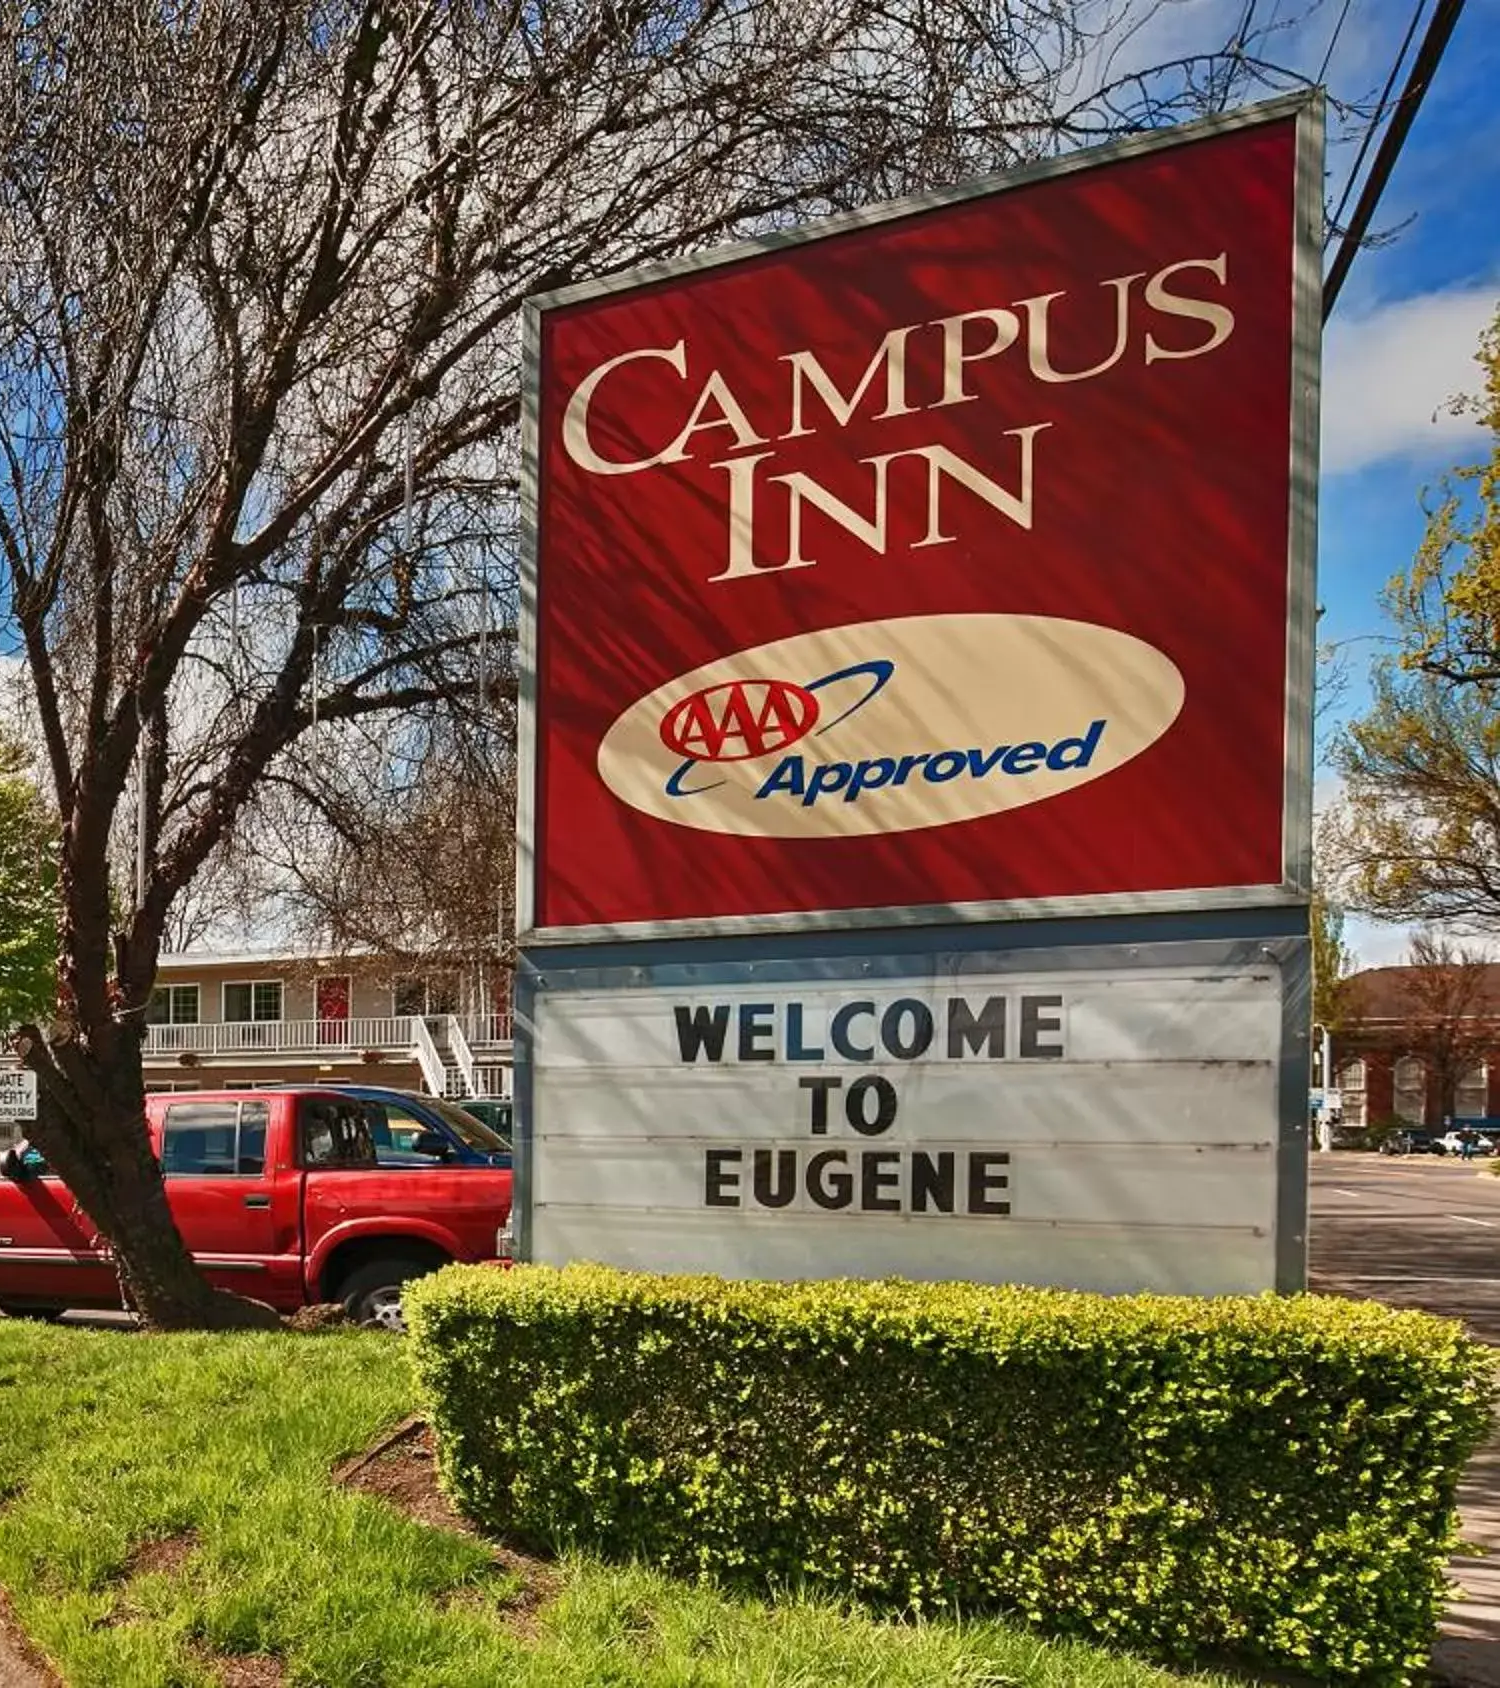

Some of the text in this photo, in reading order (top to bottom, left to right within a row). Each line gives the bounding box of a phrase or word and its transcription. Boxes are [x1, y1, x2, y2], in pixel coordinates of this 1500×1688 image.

[563, 253, 1234, 474] CAMPUS
[708, 423, 1052, 582] INN
[674, 682, 807, 758] AAA
[754, 721, 1106, 806] Approved
[674, 996, 1064, 1063] WELCOME
[798, 1075, 898, 1137] TO
[705, 1149, 1011, 1216] EUGENE
